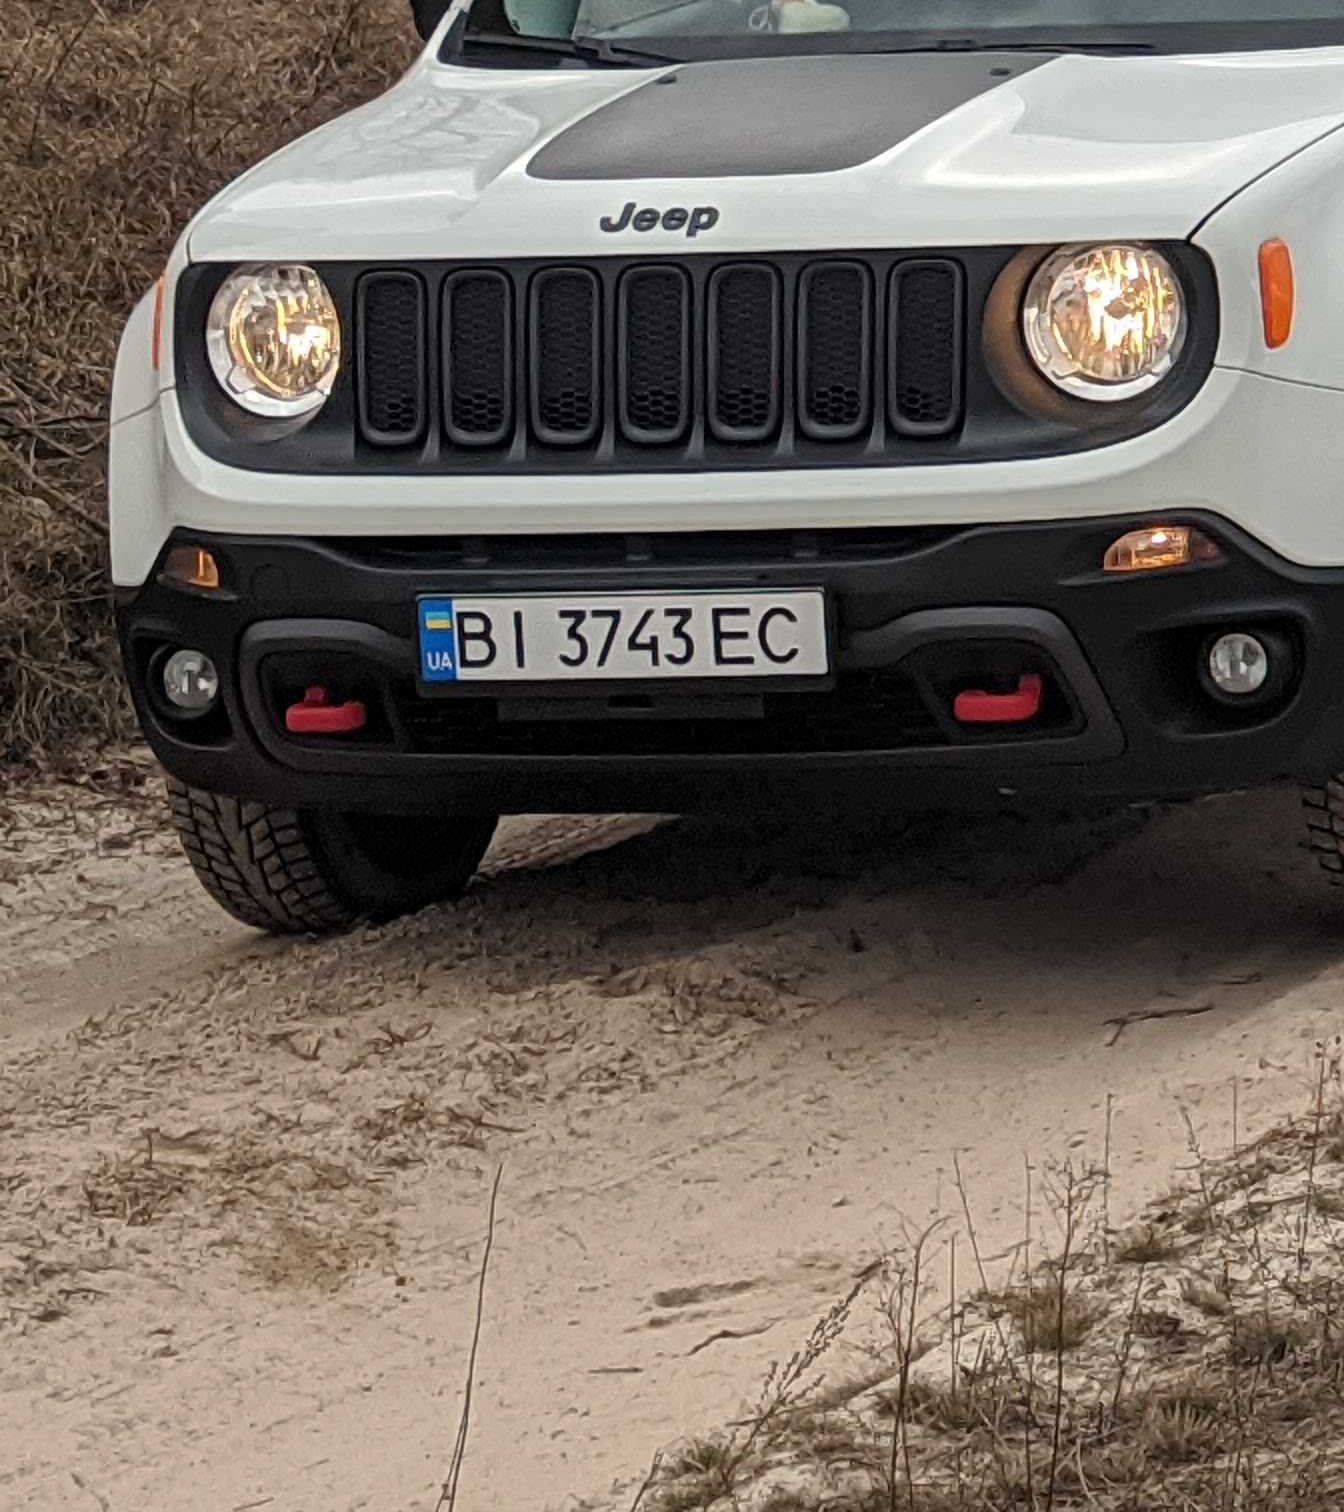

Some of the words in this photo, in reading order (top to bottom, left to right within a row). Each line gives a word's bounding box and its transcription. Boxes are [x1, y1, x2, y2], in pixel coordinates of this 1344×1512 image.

[599, 201, 720, 238] Jeep
[456, 609, 525, 669] BI
[557, 607, 695, 669] 3743
[711, 606, 799, 666] EC
[426, 651, 453, 671] UA
